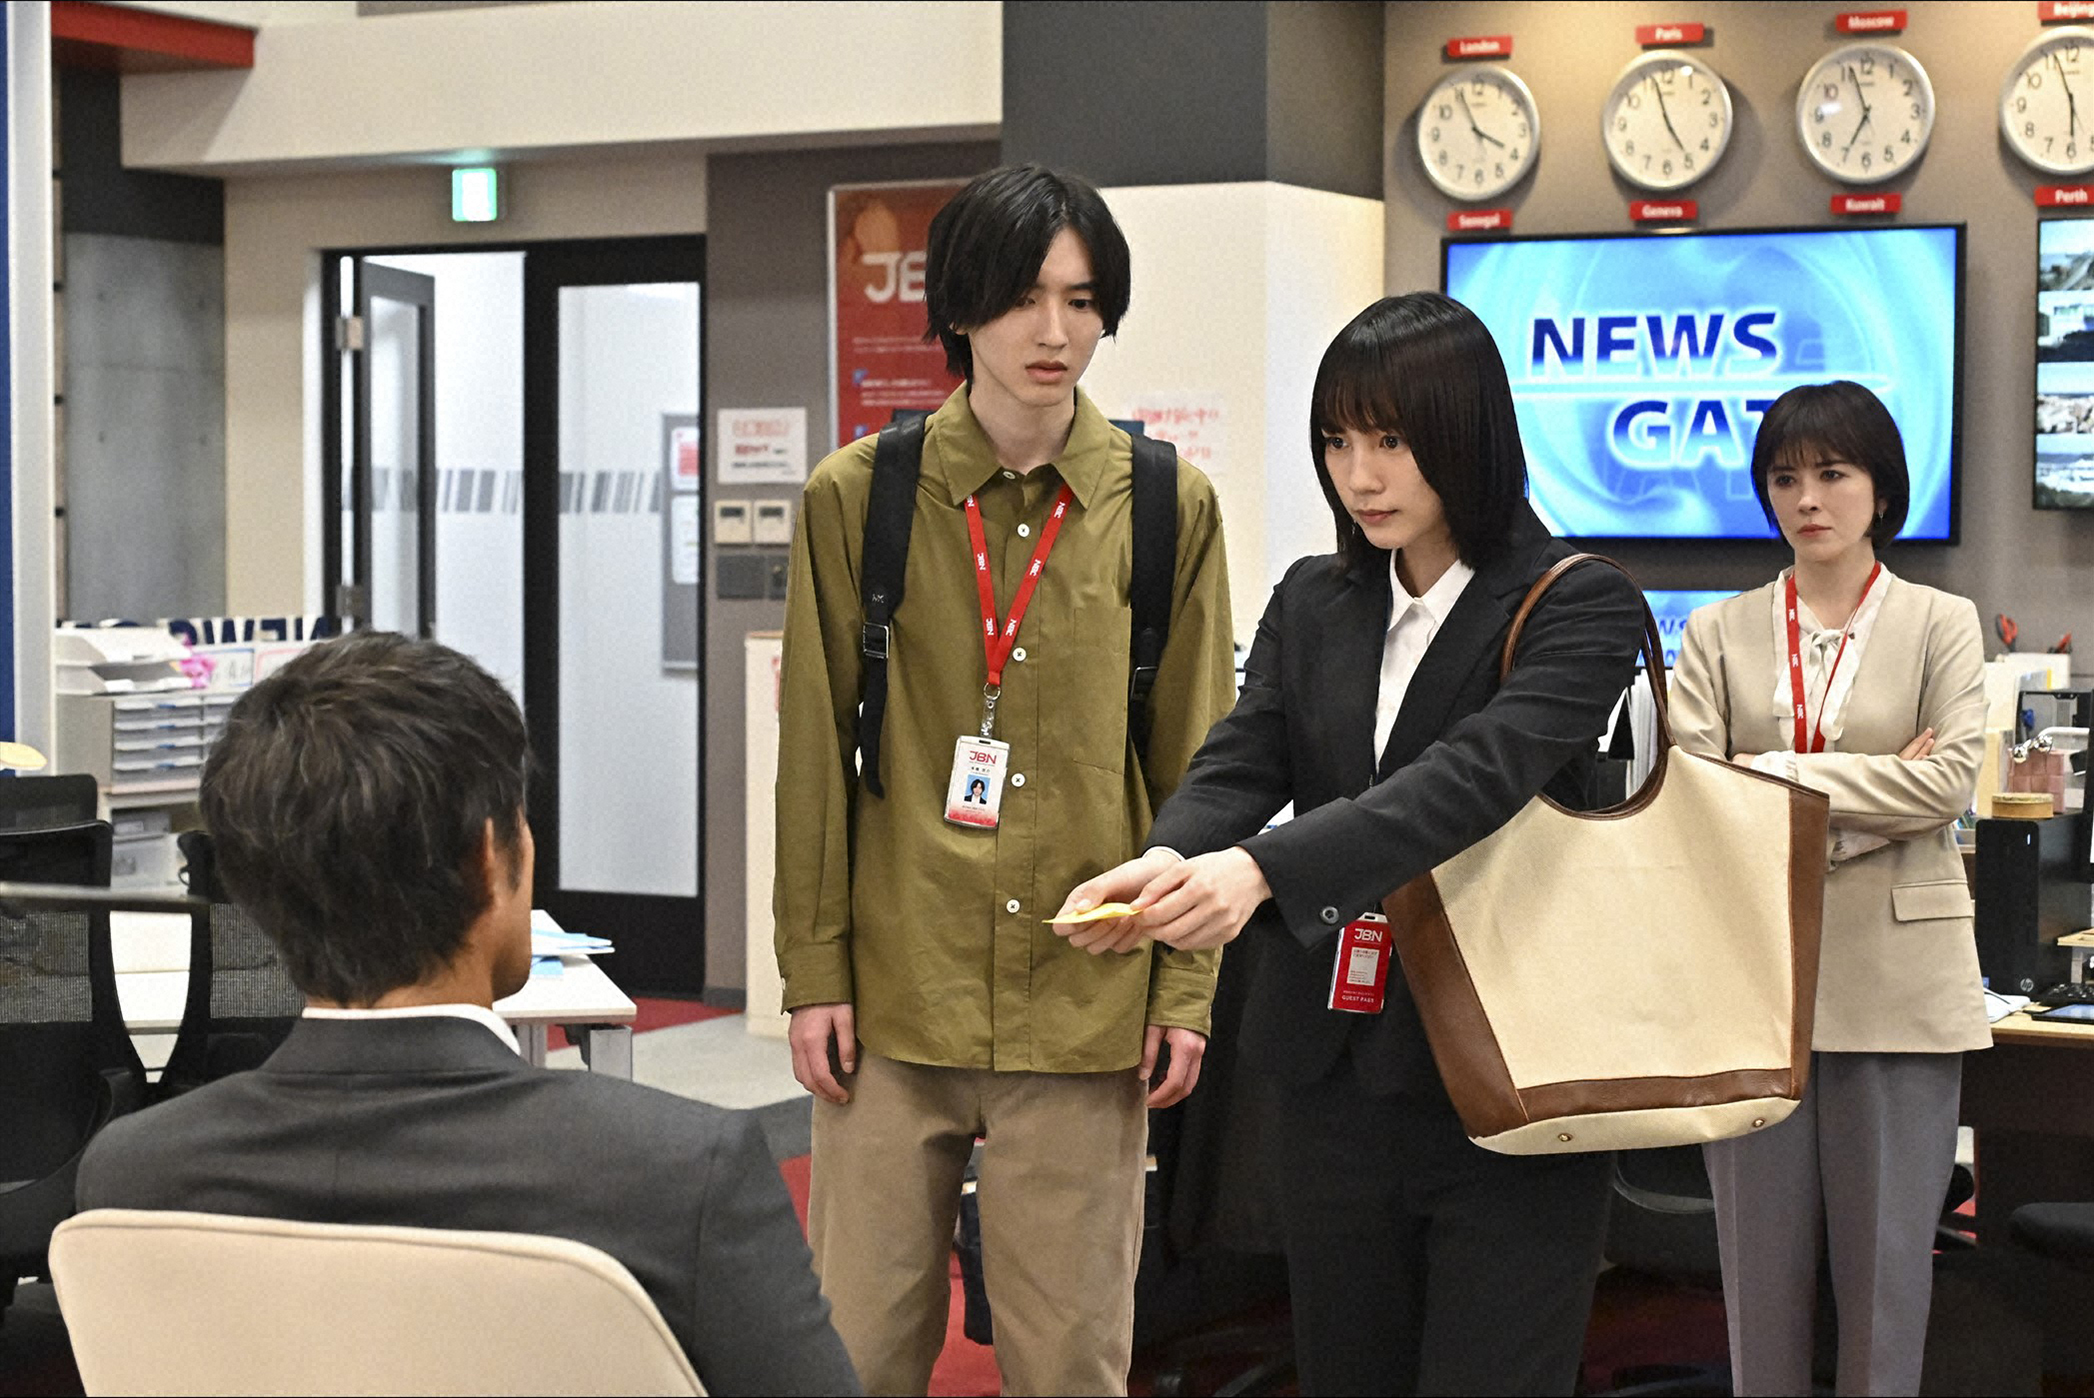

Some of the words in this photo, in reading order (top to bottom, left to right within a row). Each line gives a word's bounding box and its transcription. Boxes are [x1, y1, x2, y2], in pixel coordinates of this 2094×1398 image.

[1848, 15, 1894, 29] Moscow
[1655, 27, 1682, 41] Paris
[1460, 40, 1499, 54] London
[2065, 45, 2080, 63] 12
[1861, 57, 1875, 75] 12
[1662, 67, 1674, 84] 12
[2026, 71, 2041, 89] 10
[1824, 83, 1839, 100] 10
[1902, 79, 1912, 96] 2
[1626, 92, 1640, 109] 10
[1701, 88, 1711, 105] 2
[1910, 103, 1920, 120] 3
[2017, 97, 2026, 113] 9
[1709, 111, 1718, 127] 3
[1814, 106, 1824, 124] 9
[1618, 116, 1627, 131] 9
[2025, 121, 2034, 138] 8
[1700, 137, 1709, 151] 4
[1822, 132, 1832, 148] 8
[1901, 129, 1910, 144] 4
[1625, 139, 1634, 155] 8
[2044, 137, 2054, 153] 7
[2066, 142, 2076, 159] 6
[1643, 154, 1651, 170] 7
[1684, 153, 1694, 169] 5
[1842, 147, 1850, 163] 7
[1862, 152, 1871, 168] 6
[1884, 145, 1894, 163] 5
[1663, 159, 1672, 175] 6
[2055, 188, 2088, 203] Perth
[1642, 204, 1682, 218] Geneva
[1845, 197, 1885, 211] Kuwait
[1459, 212, 1500, 229] Senegal
[1531, 312, 1778, 376] NEWS
[1612, 398, 1778, 464] GA
[969, 750, 997, 764] JBN
[1354, 928, 1383, 942] JBN
[2020, 978, 2034, 992] hp
